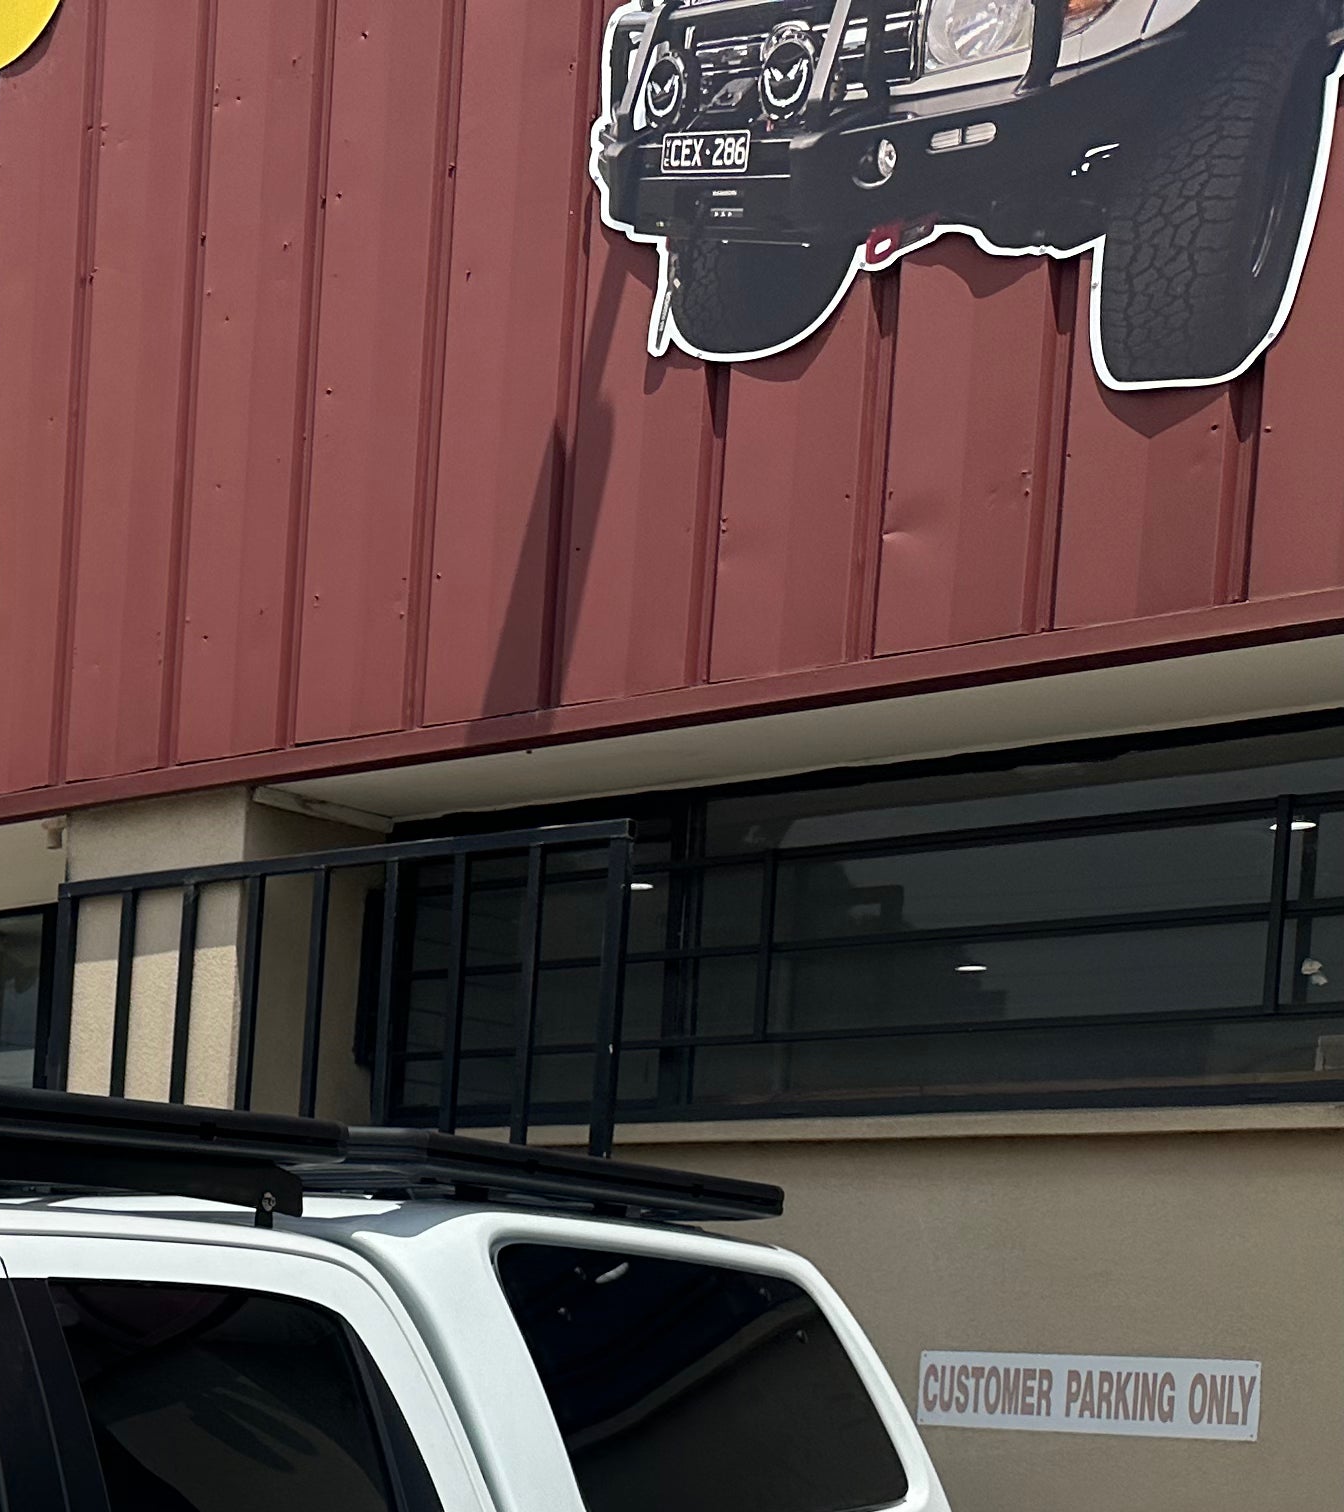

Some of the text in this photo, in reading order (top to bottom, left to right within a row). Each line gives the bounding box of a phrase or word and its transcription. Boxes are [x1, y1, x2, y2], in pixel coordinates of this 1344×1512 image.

[923, 1364, 1257, 1426] CUSTOMER PARKING ONLY
